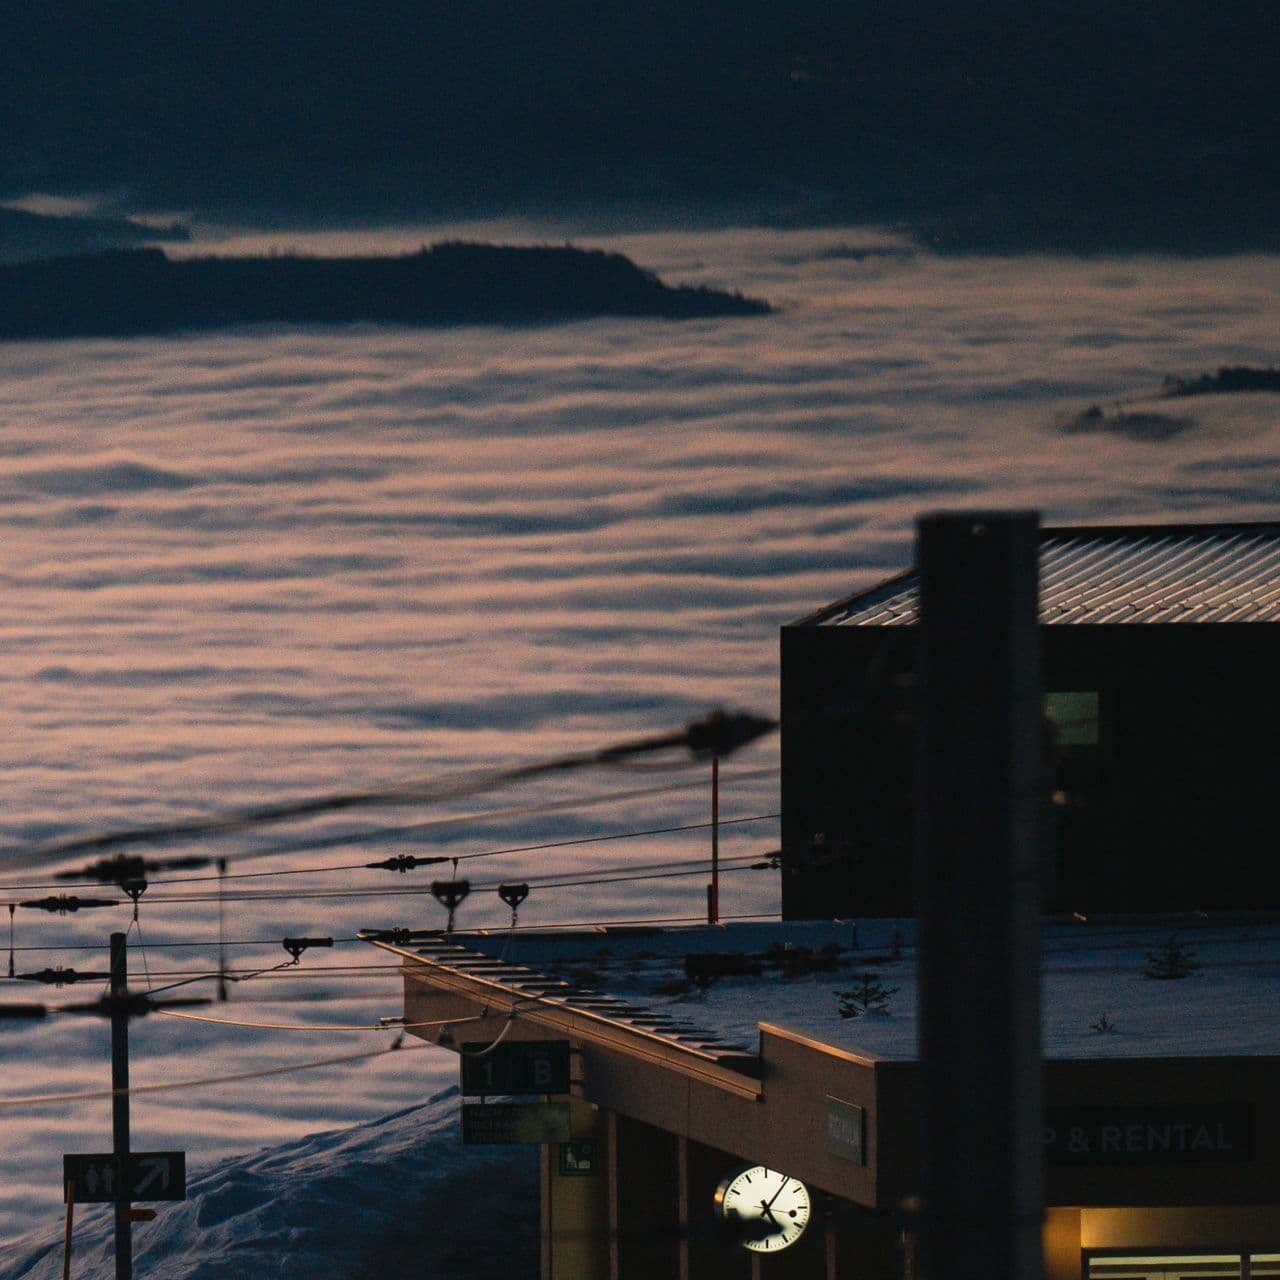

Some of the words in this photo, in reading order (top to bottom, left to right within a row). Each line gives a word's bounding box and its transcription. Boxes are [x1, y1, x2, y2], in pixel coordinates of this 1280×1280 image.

[534, 1059, 553, 1086] B
[1068, 1125, 1090, 1153] &
[1100, 1121, 1233, 1153] RENTAL
